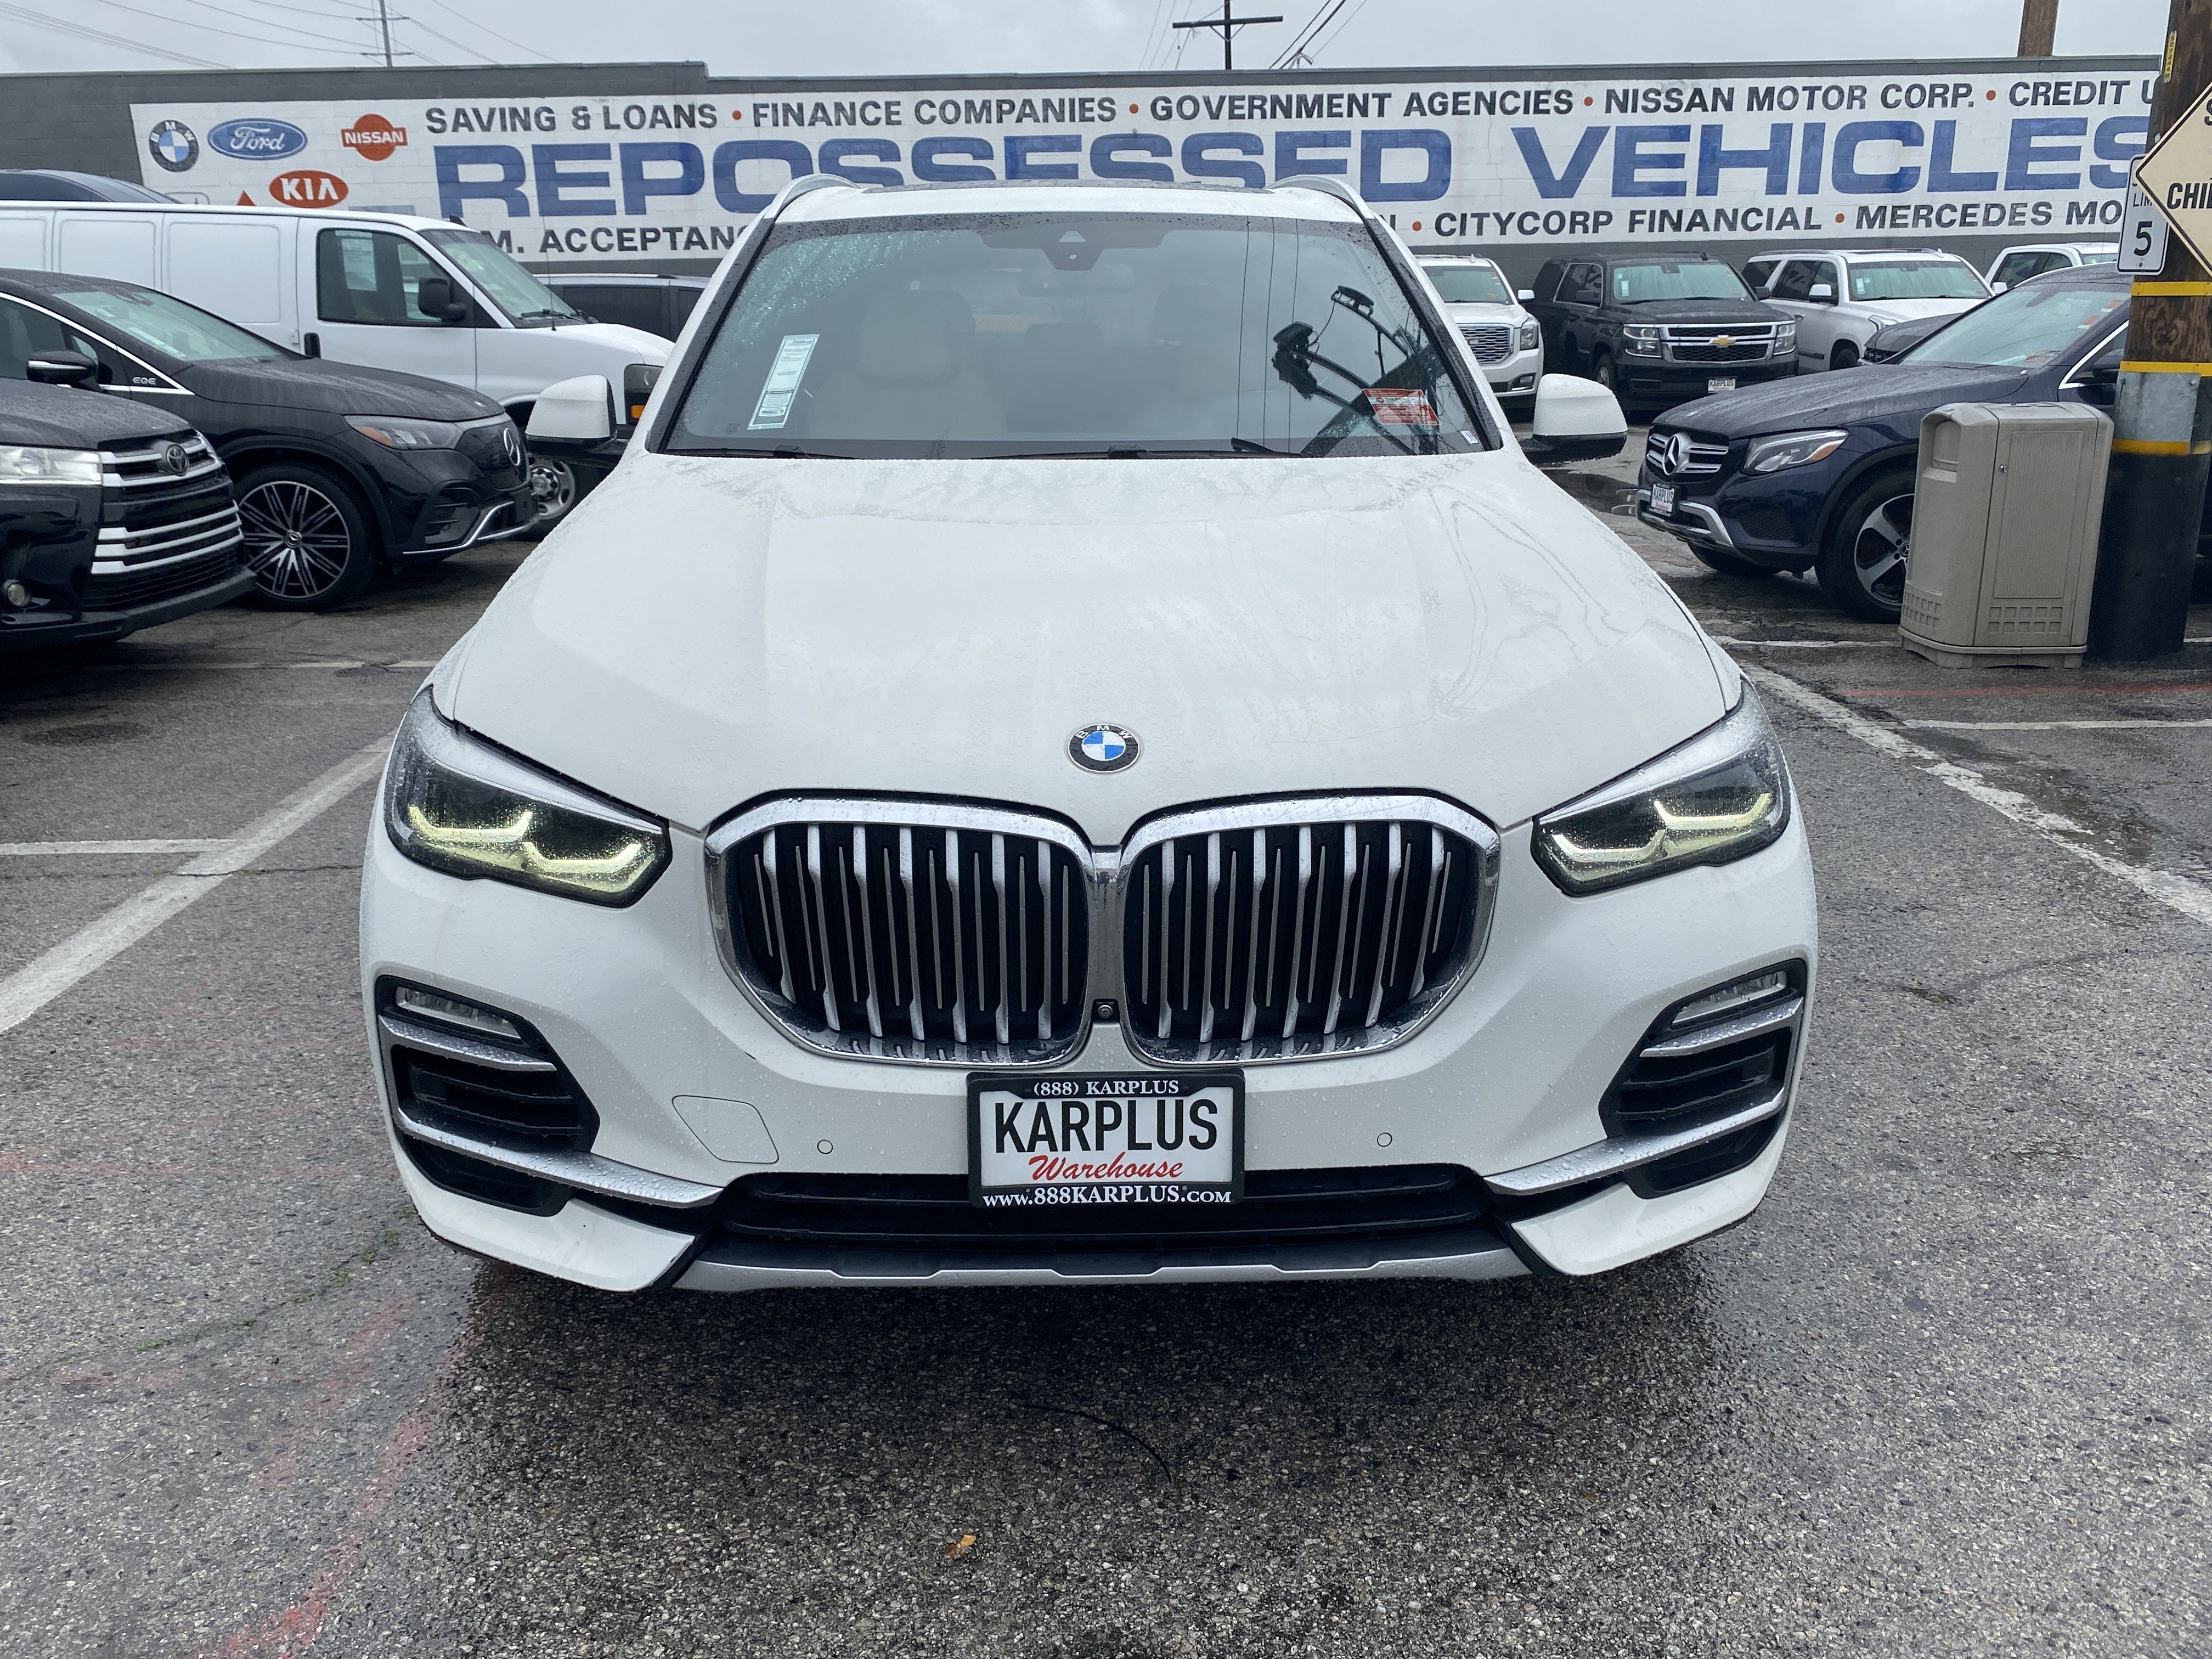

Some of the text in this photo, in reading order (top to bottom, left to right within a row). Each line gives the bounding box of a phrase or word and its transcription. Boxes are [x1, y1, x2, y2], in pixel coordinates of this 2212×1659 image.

[426, 106, 556, 133] SAVING
[572, 105, 591, 130] &
[604, 104, 718, 130] LOANS
[753, 100, 902, 127] FINANCE
[915, 97, 1116, 125] COMPANIES
[1150, 92, 1392, 121] GOVERNMENT
[1403, 89, 1573, 117] AGENCIES
[1605, 86, 1735, 114] NISSAN
[1747, 84, 1866, 111] MOTOR
[1881, 82, 1974, 109] CORP.
[2009, 80, 2130, 107] CREDIT
[150, 121, 195, 143] BMW
[230, 126, 285, 153] Ford
[345, 131, 404, 145] NISSAN
[433, 116, 2150, 219] REPOSSESSED VEHICLES
[280, 177, 340, 201] KIA
[1435, 200, 2123, 237] CITYCORP FINANCIAL MERCEDES MO
[539, 224, 748, 253] ACCEPTAN
[2133, 221, 2153, 257] 5
[132, 376, 156, 385] EQE
[1709, 379, 1734, 387] KARPLUS
[1074, 725, 1133, 739] BMW
[1034, 1079, 1179, 1096] (888) KARPLUS
[995, 1098, 1218, 1153] KARPLUS
[1028, 1152, 1183, 1181] Warehouse
